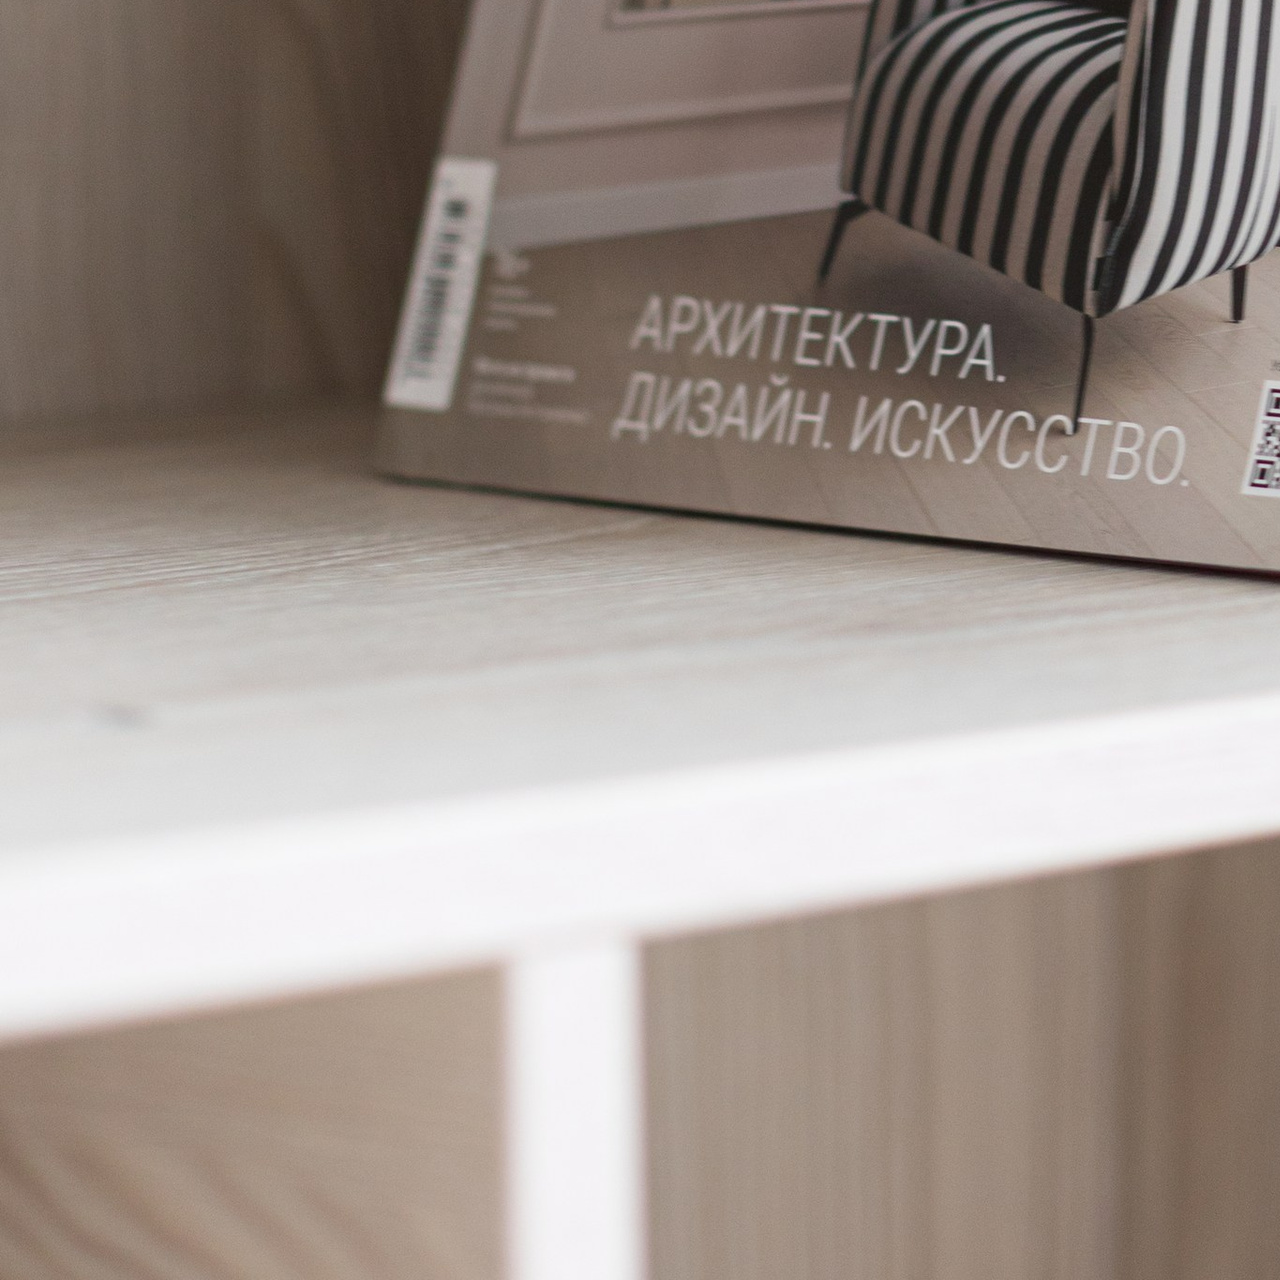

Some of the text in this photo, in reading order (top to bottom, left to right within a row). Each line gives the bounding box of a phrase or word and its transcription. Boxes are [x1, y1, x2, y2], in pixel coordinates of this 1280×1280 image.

[630, 295, 1007, 383] АРХИТЕКТУРА.
[611, 371, 833, 450] ДИЗАЙН.
[849, 396, 1190, 487] ИСКУССТВО.
